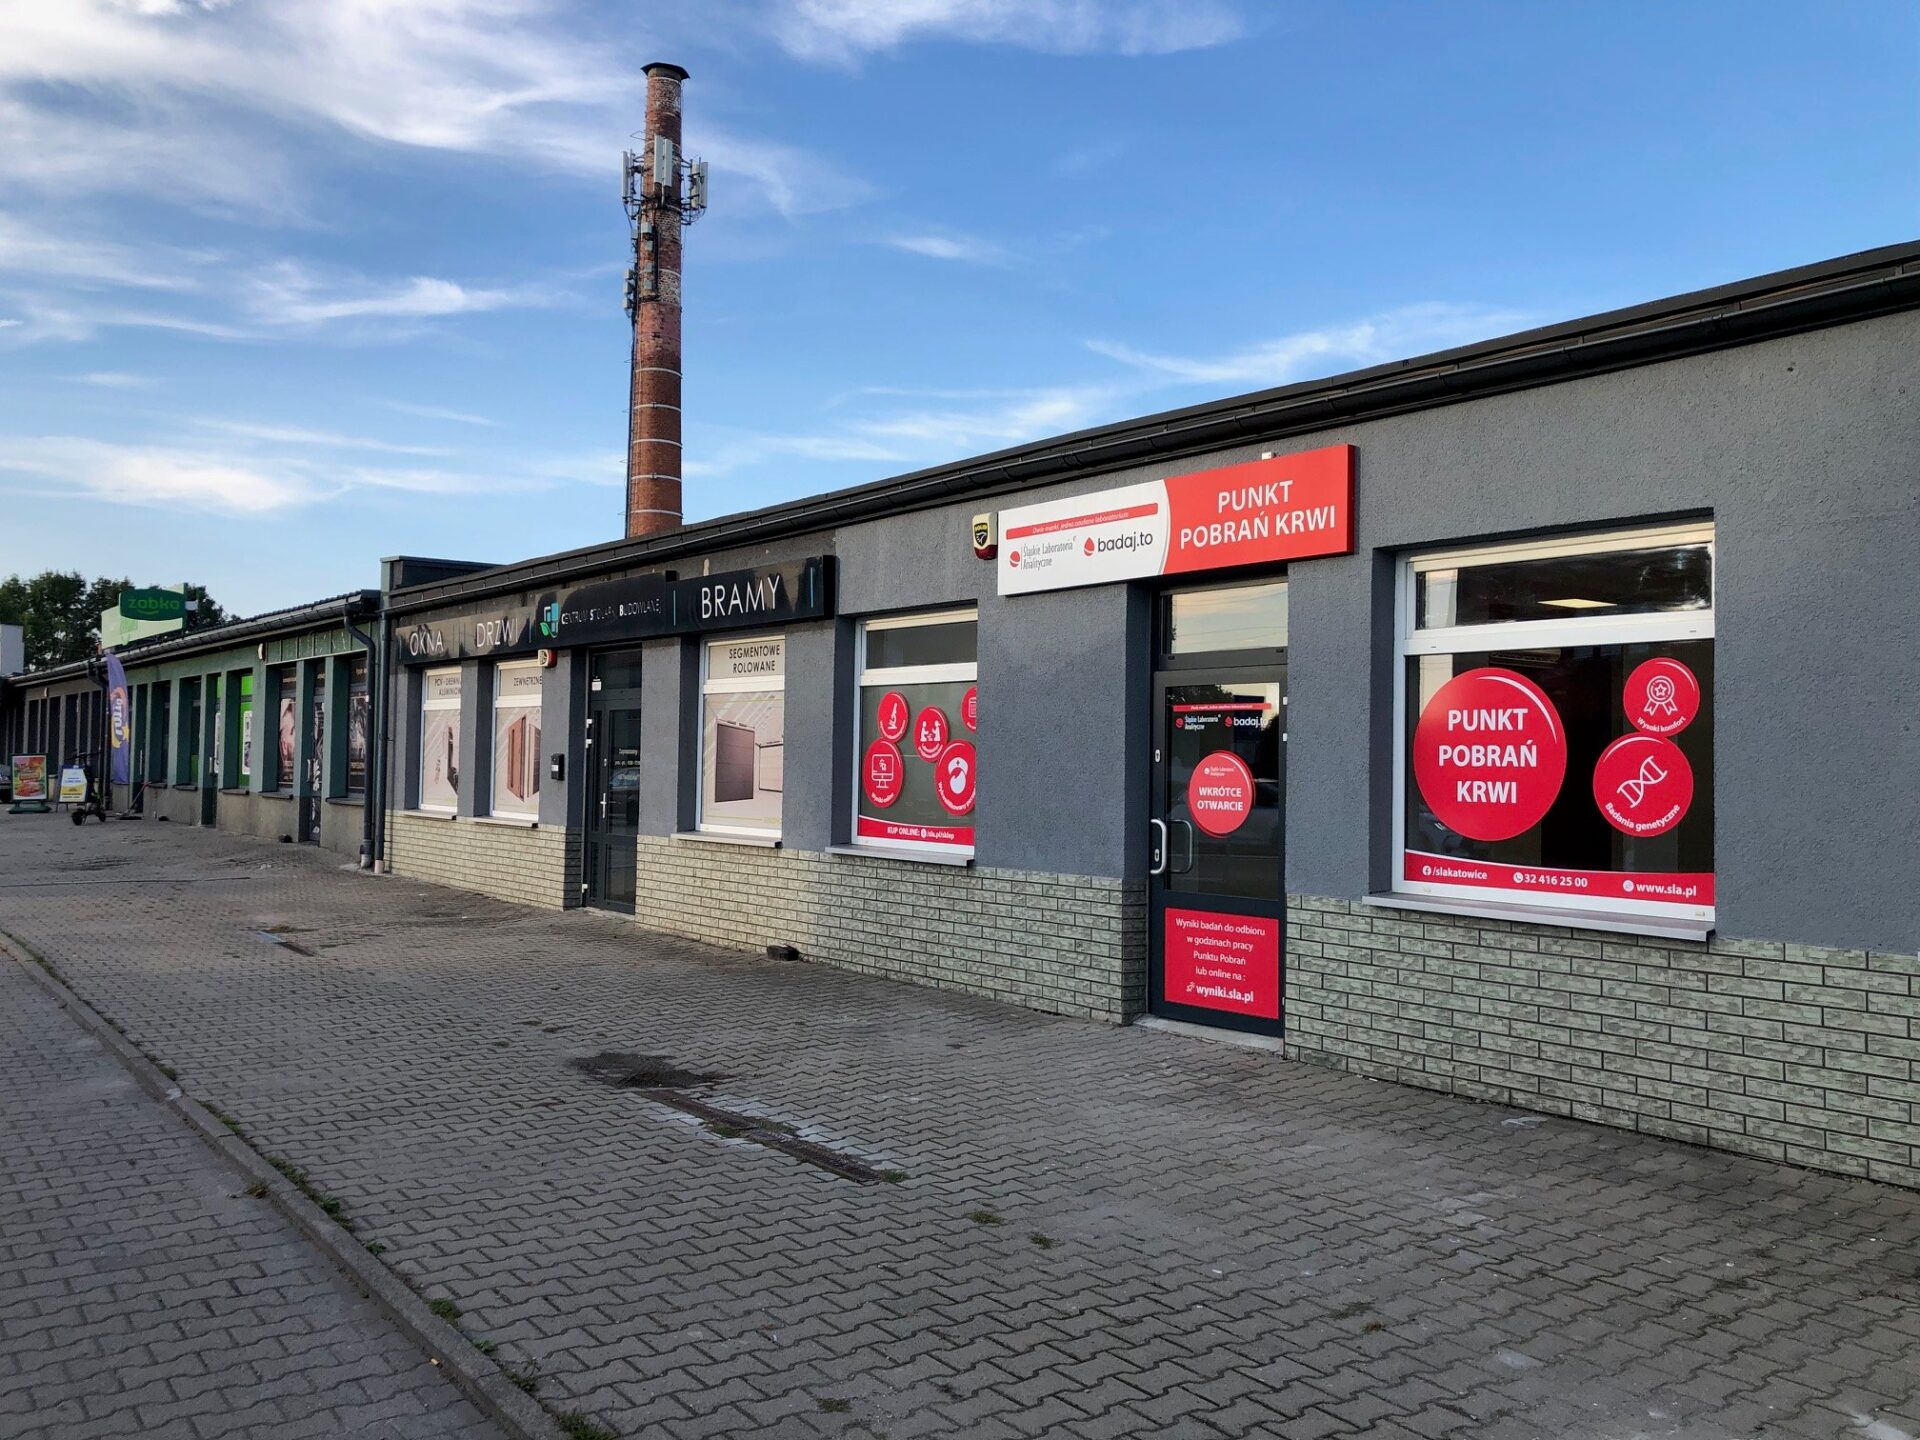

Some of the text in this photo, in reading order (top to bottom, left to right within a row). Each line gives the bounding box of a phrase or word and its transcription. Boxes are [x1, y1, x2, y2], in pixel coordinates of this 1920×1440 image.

[1218, 480, 1293, 513] PUNKT
[1180, 505, 1336, 550] POBRAŃ KRWI
[1097, 531, 1153, 553] badaj.to
[701, 575, 780, 619] BRAMY
[409, 618, 519, 656] OKNA DRZWI
[729, 644, 780, 659] SEGMENTOWE
[732, 660, 776, 673] ROLOWANE
[1233, 716, 1269, 729] badaj.to
[1448, 708, 1529, 731] PUNKT
[1637, 716, 1686, 732] Wysoki komfort
[1439, 740, 1537, 767] POBRAŃ
[1198, 785, 1242, 797] WKRÓTCE
[1457, 780, 1517, 804] KRWI
[1197, 800, 1244, 811] OTWARCIE
[1605, 802, 1680, 831] Badania genetyczne
[1432, 867, 1488, 880] /slakatowice
[1524, 873, 1588, 888] 32 416 25 00
[1636, 884, 1697, 898] www.sla.pl
[1175, 917, 1266, 936] Wyniki badań do odbioru
[1194, 936, 1232, 948] godzinach
[1233, 943, 1254, 952] pracy
[1193, 951, 1246, 965] Punktu Pobrań
[1195, 966, 1207, 975] lub
[1208, 968, 1232, 979] online
[1232, 973, 1242, 981] na
[1196, 985, 1254, 1004] wyniki.sla.pl
